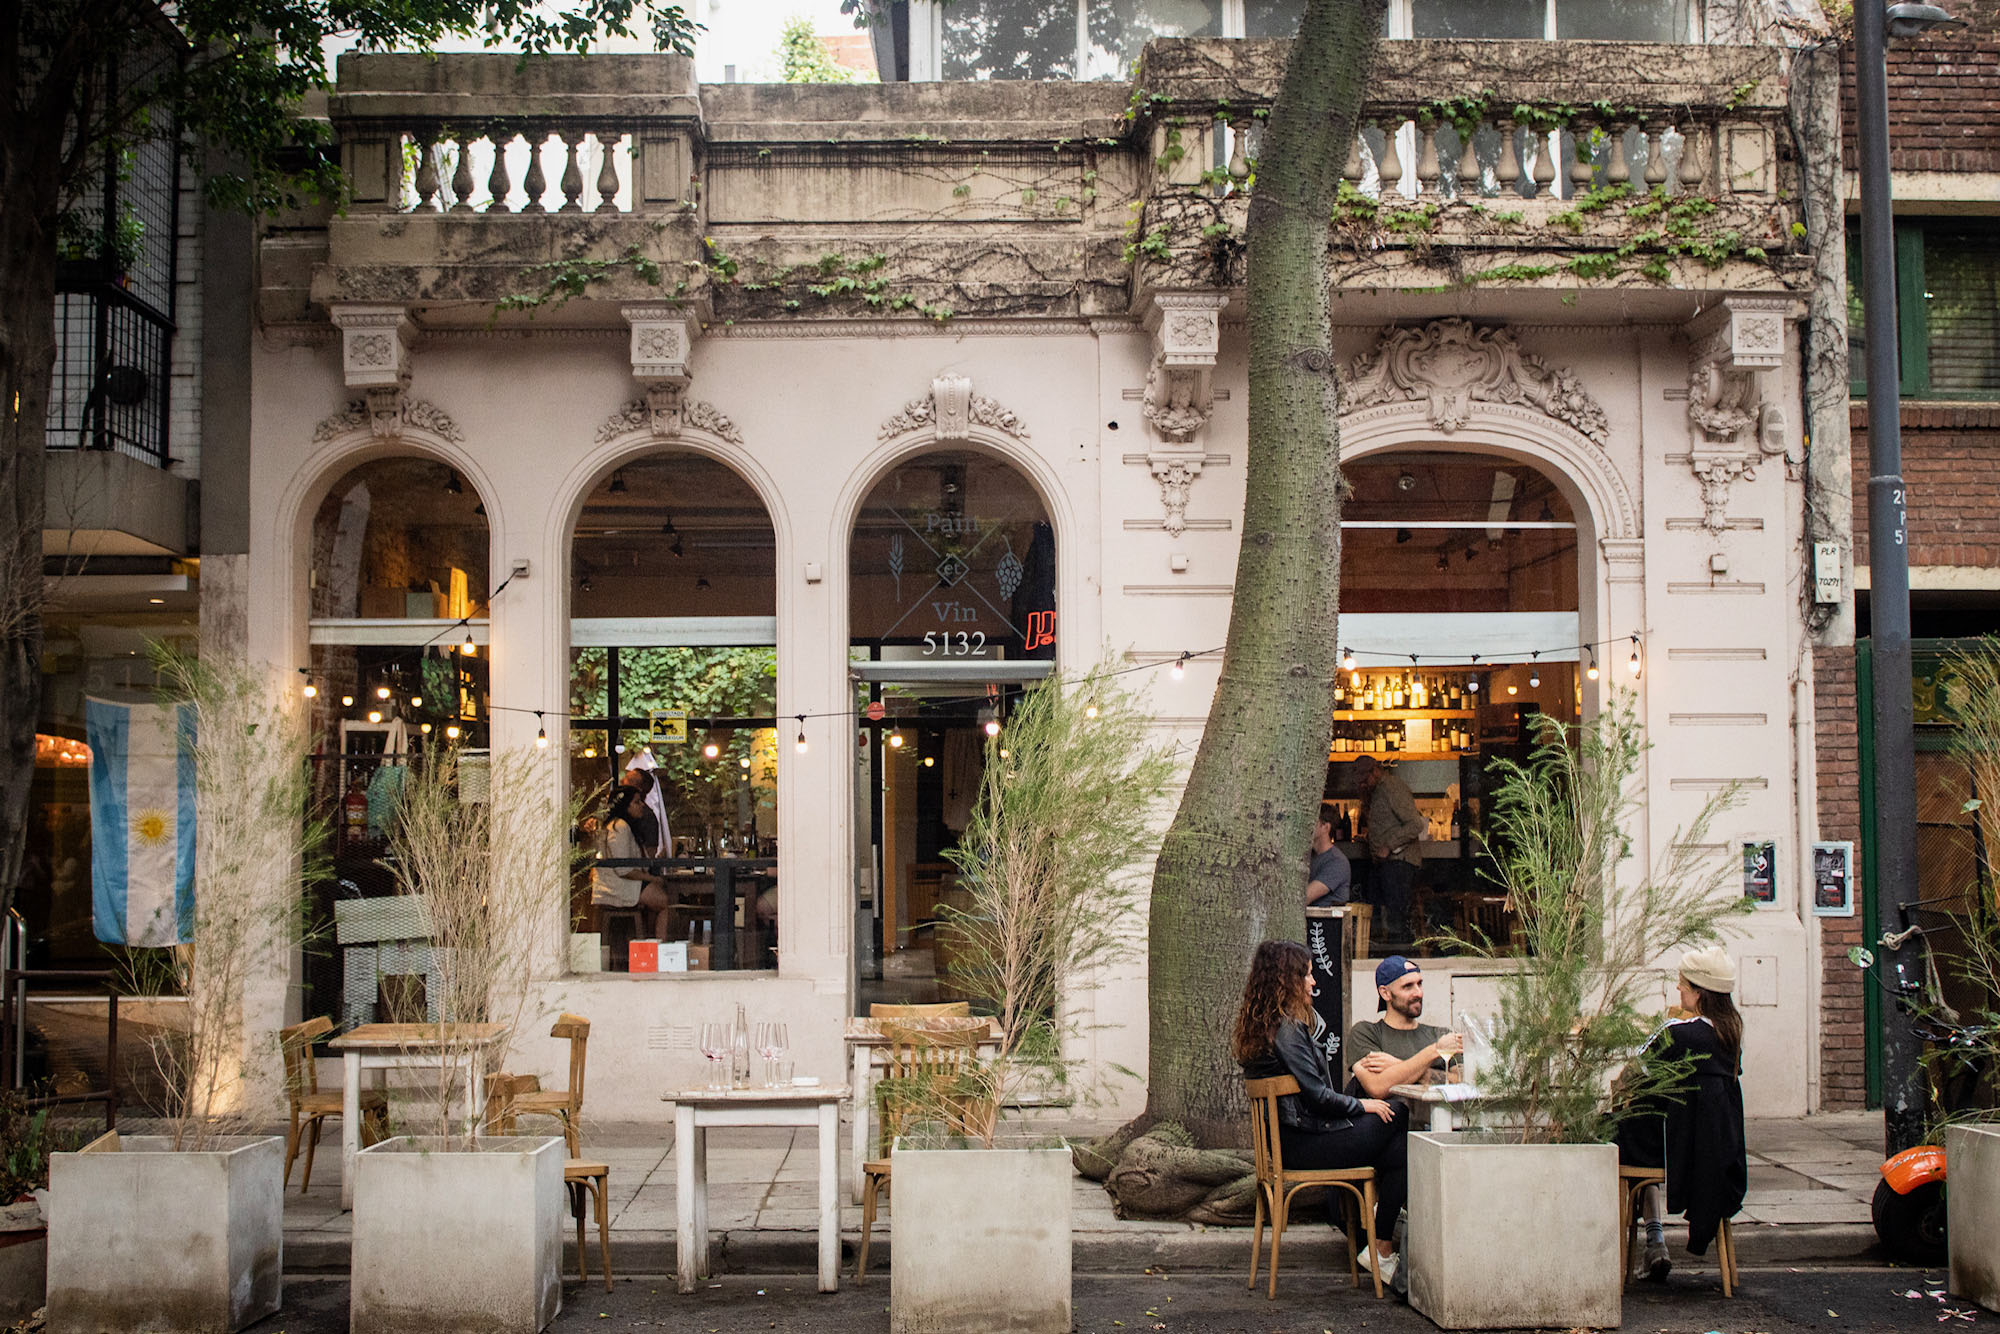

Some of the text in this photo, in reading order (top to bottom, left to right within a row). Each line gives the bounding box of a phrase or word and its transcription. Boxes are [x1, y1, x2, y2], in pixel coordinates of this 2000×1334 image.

[925, 513, 980, 533] Pain
[1821, 547, 1837, 556] PLR
[943, 561, 962, 576] et
[932, 601, 978, 622] Vin
[922, 631, 987, 656] 5132
